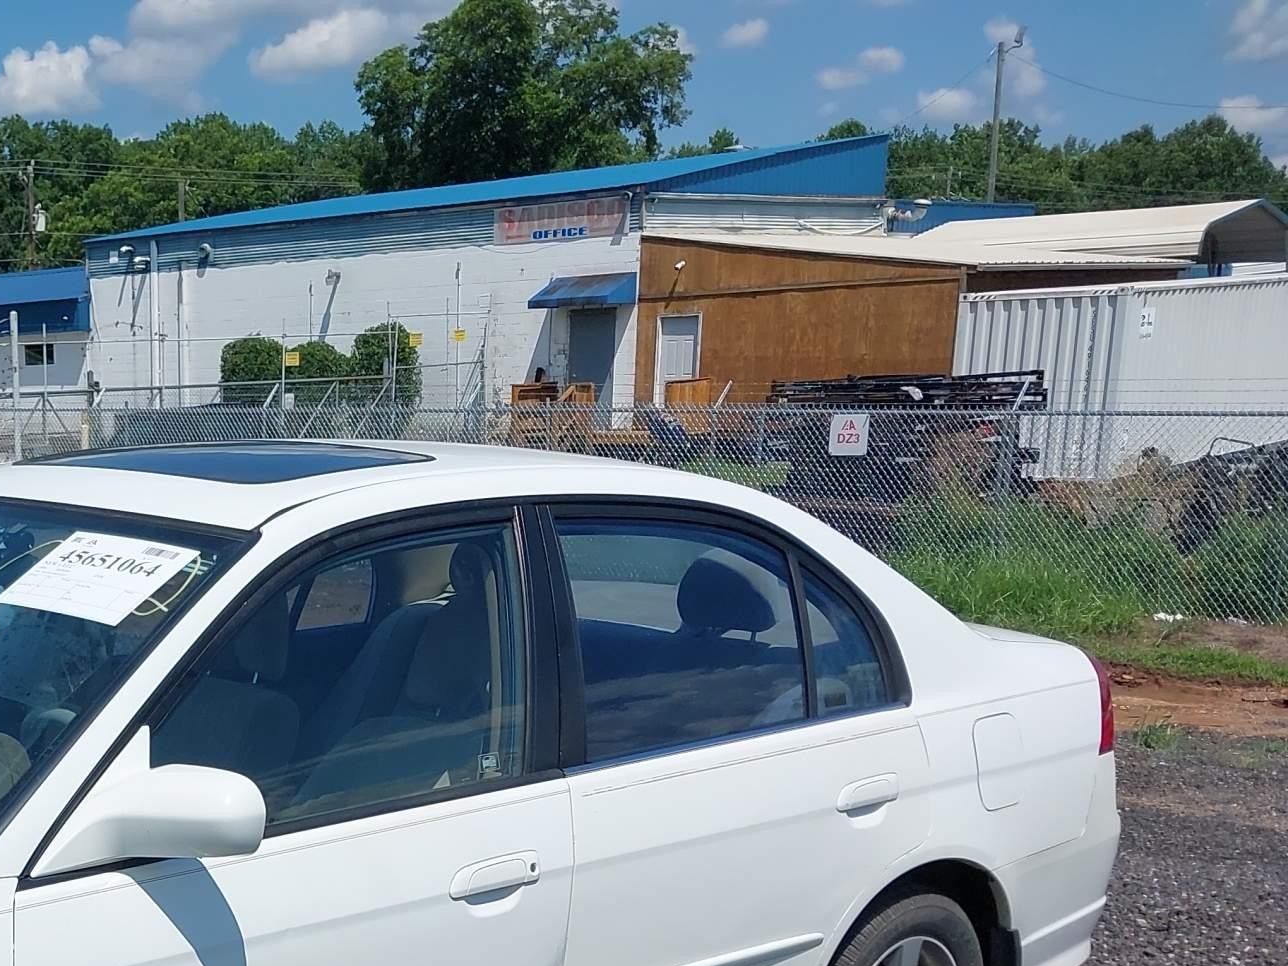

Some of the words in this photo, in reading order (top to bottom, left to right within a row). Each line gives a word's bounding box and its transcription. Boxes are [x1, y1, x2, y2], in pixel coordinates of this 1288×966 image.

[532, 226, 588, 239] OFFICE
[837, 433, 861, 444] DZ3
[58, 549, 163, 577] 45651064
